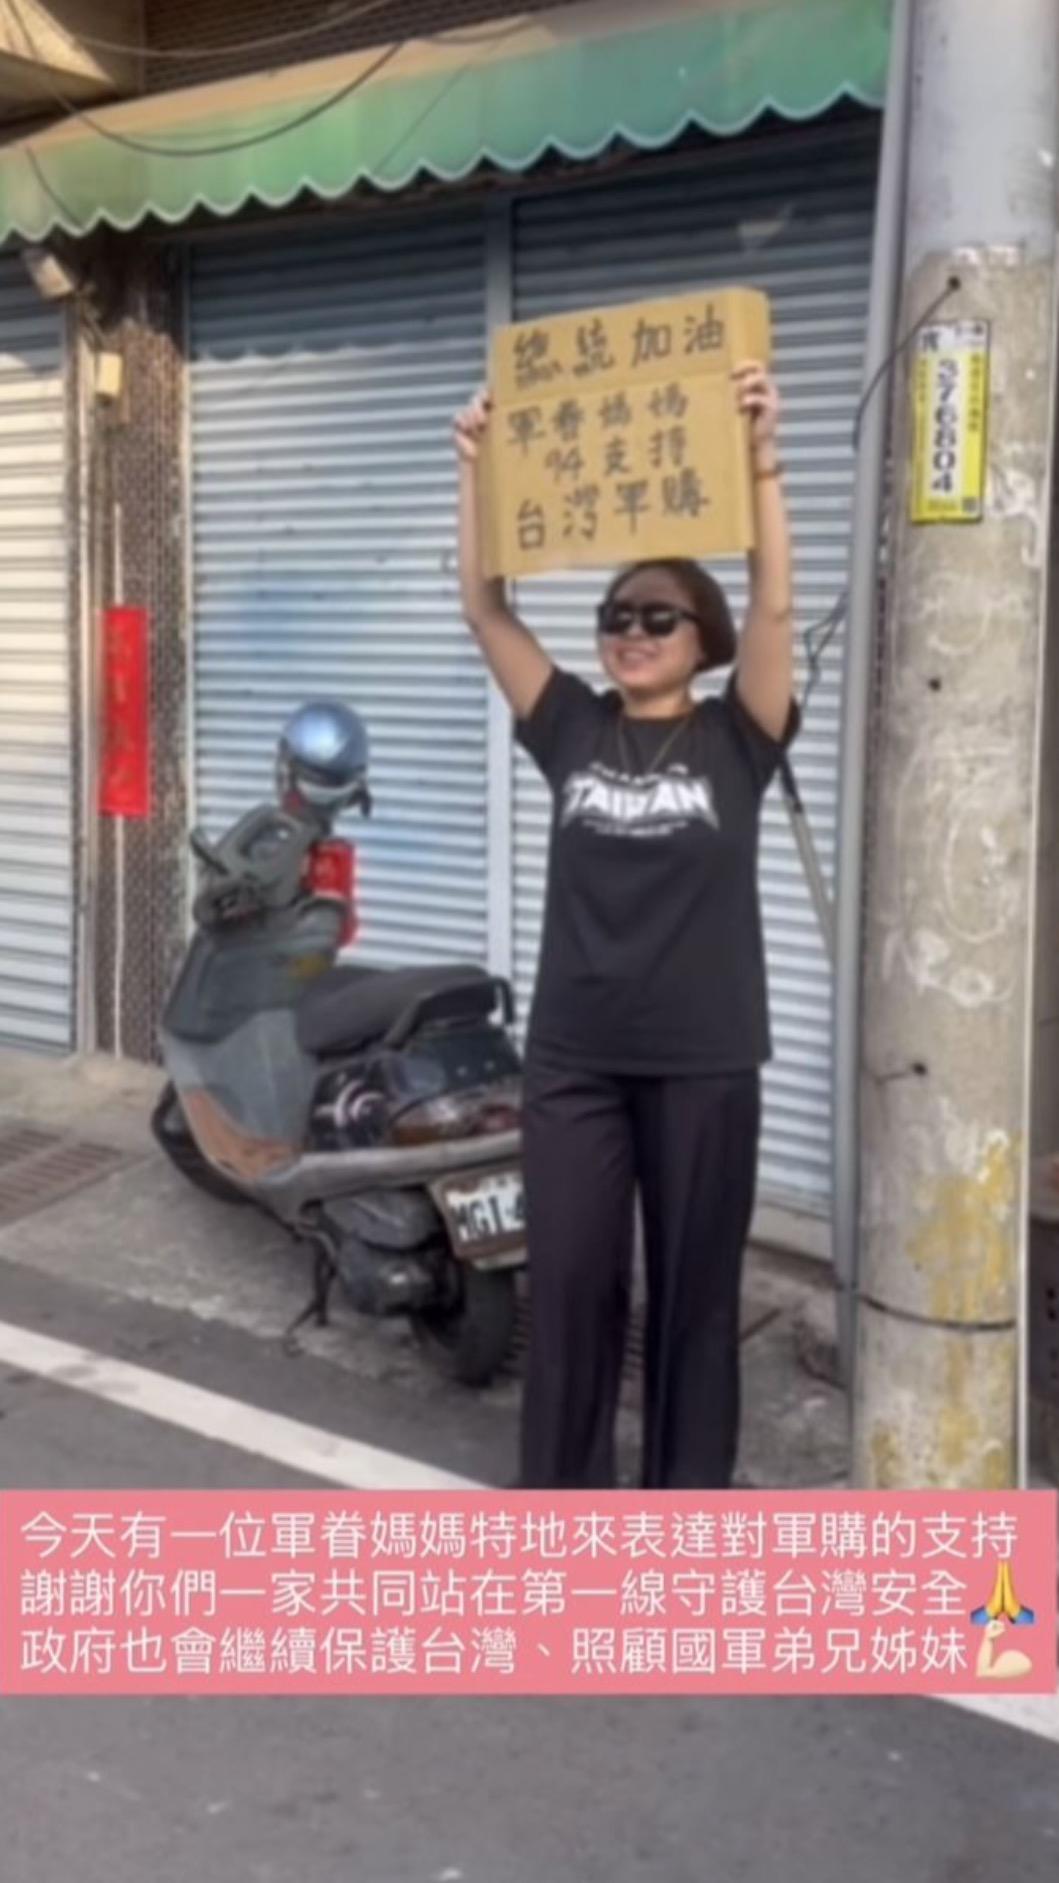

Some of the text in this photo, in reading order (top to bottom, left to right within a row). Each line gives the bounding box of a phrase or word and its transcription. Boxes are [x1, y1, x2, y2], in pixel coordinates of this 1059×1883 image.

[512, 303, 725, 389] 總統加油
[507, 382, 690, 455] 軍眷媽媽
[516, 466, 710, 551] 台灣軍購
